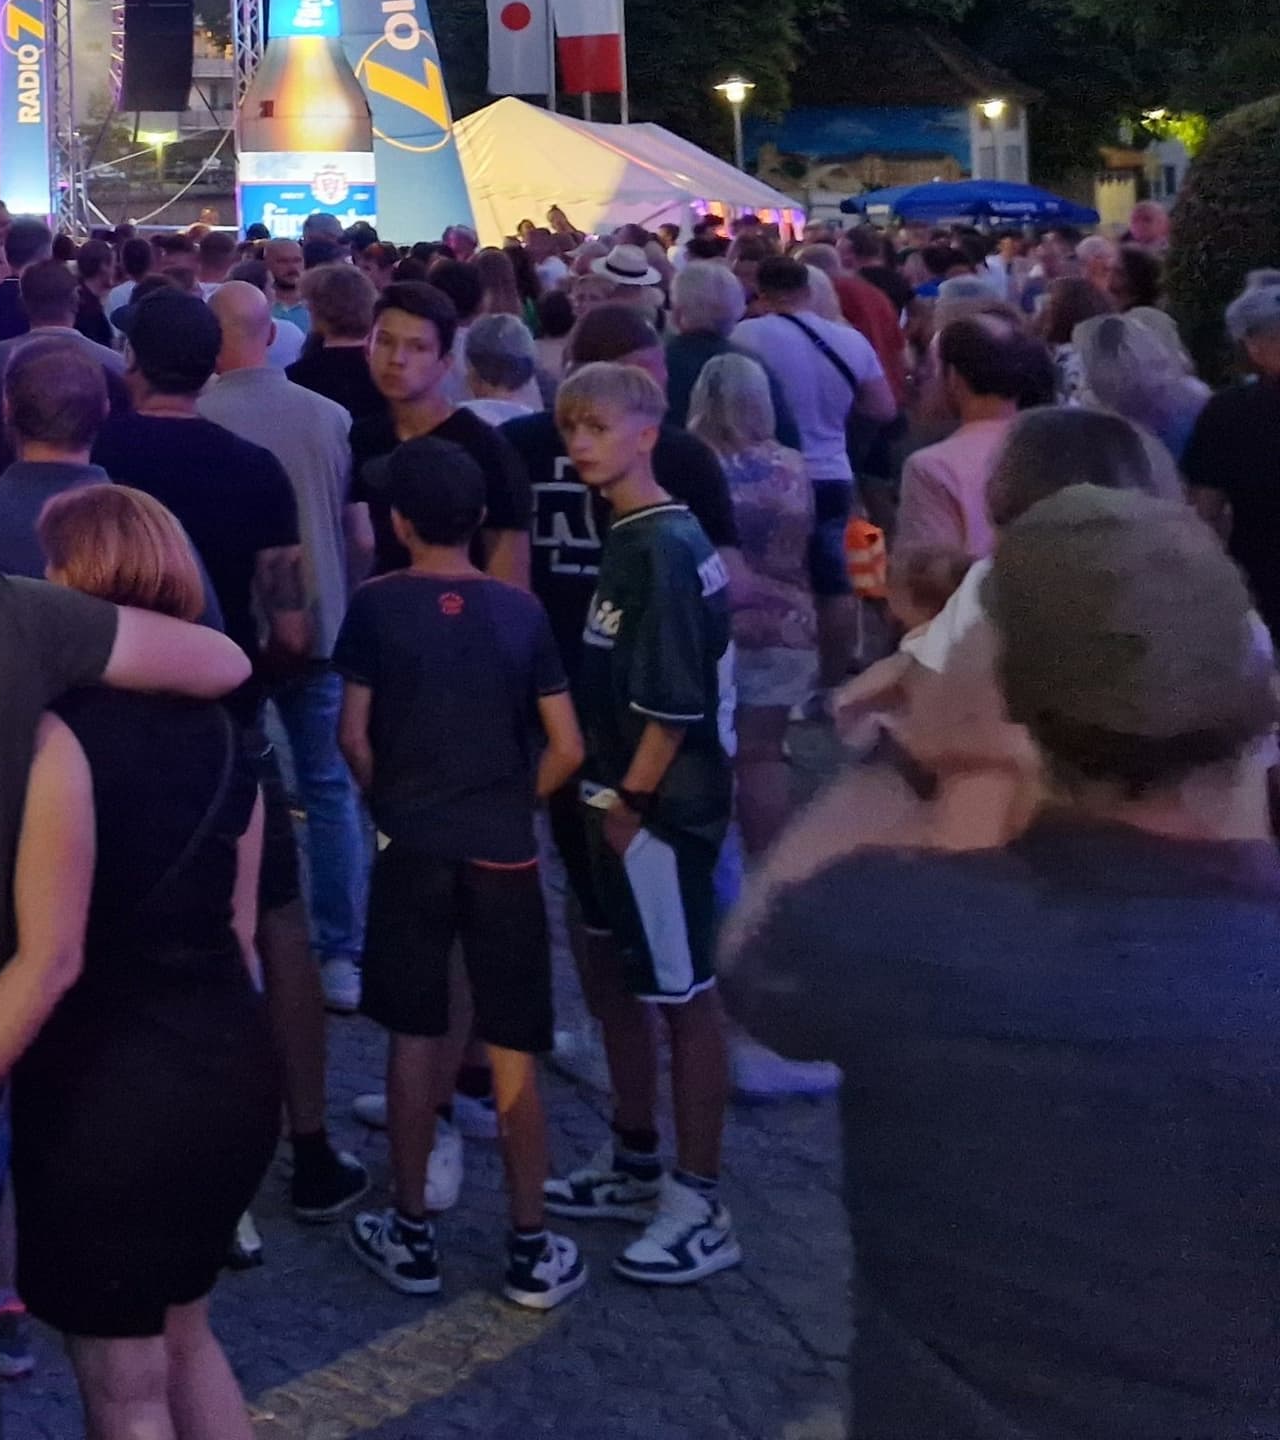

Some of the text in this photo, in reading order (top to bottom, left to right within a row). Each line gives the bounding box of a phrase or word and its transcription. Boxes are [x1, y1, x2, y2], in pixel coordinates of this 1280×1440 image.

[6, 3, 45, 124] RADIO 7
[364, 57, 450, 132] 7
